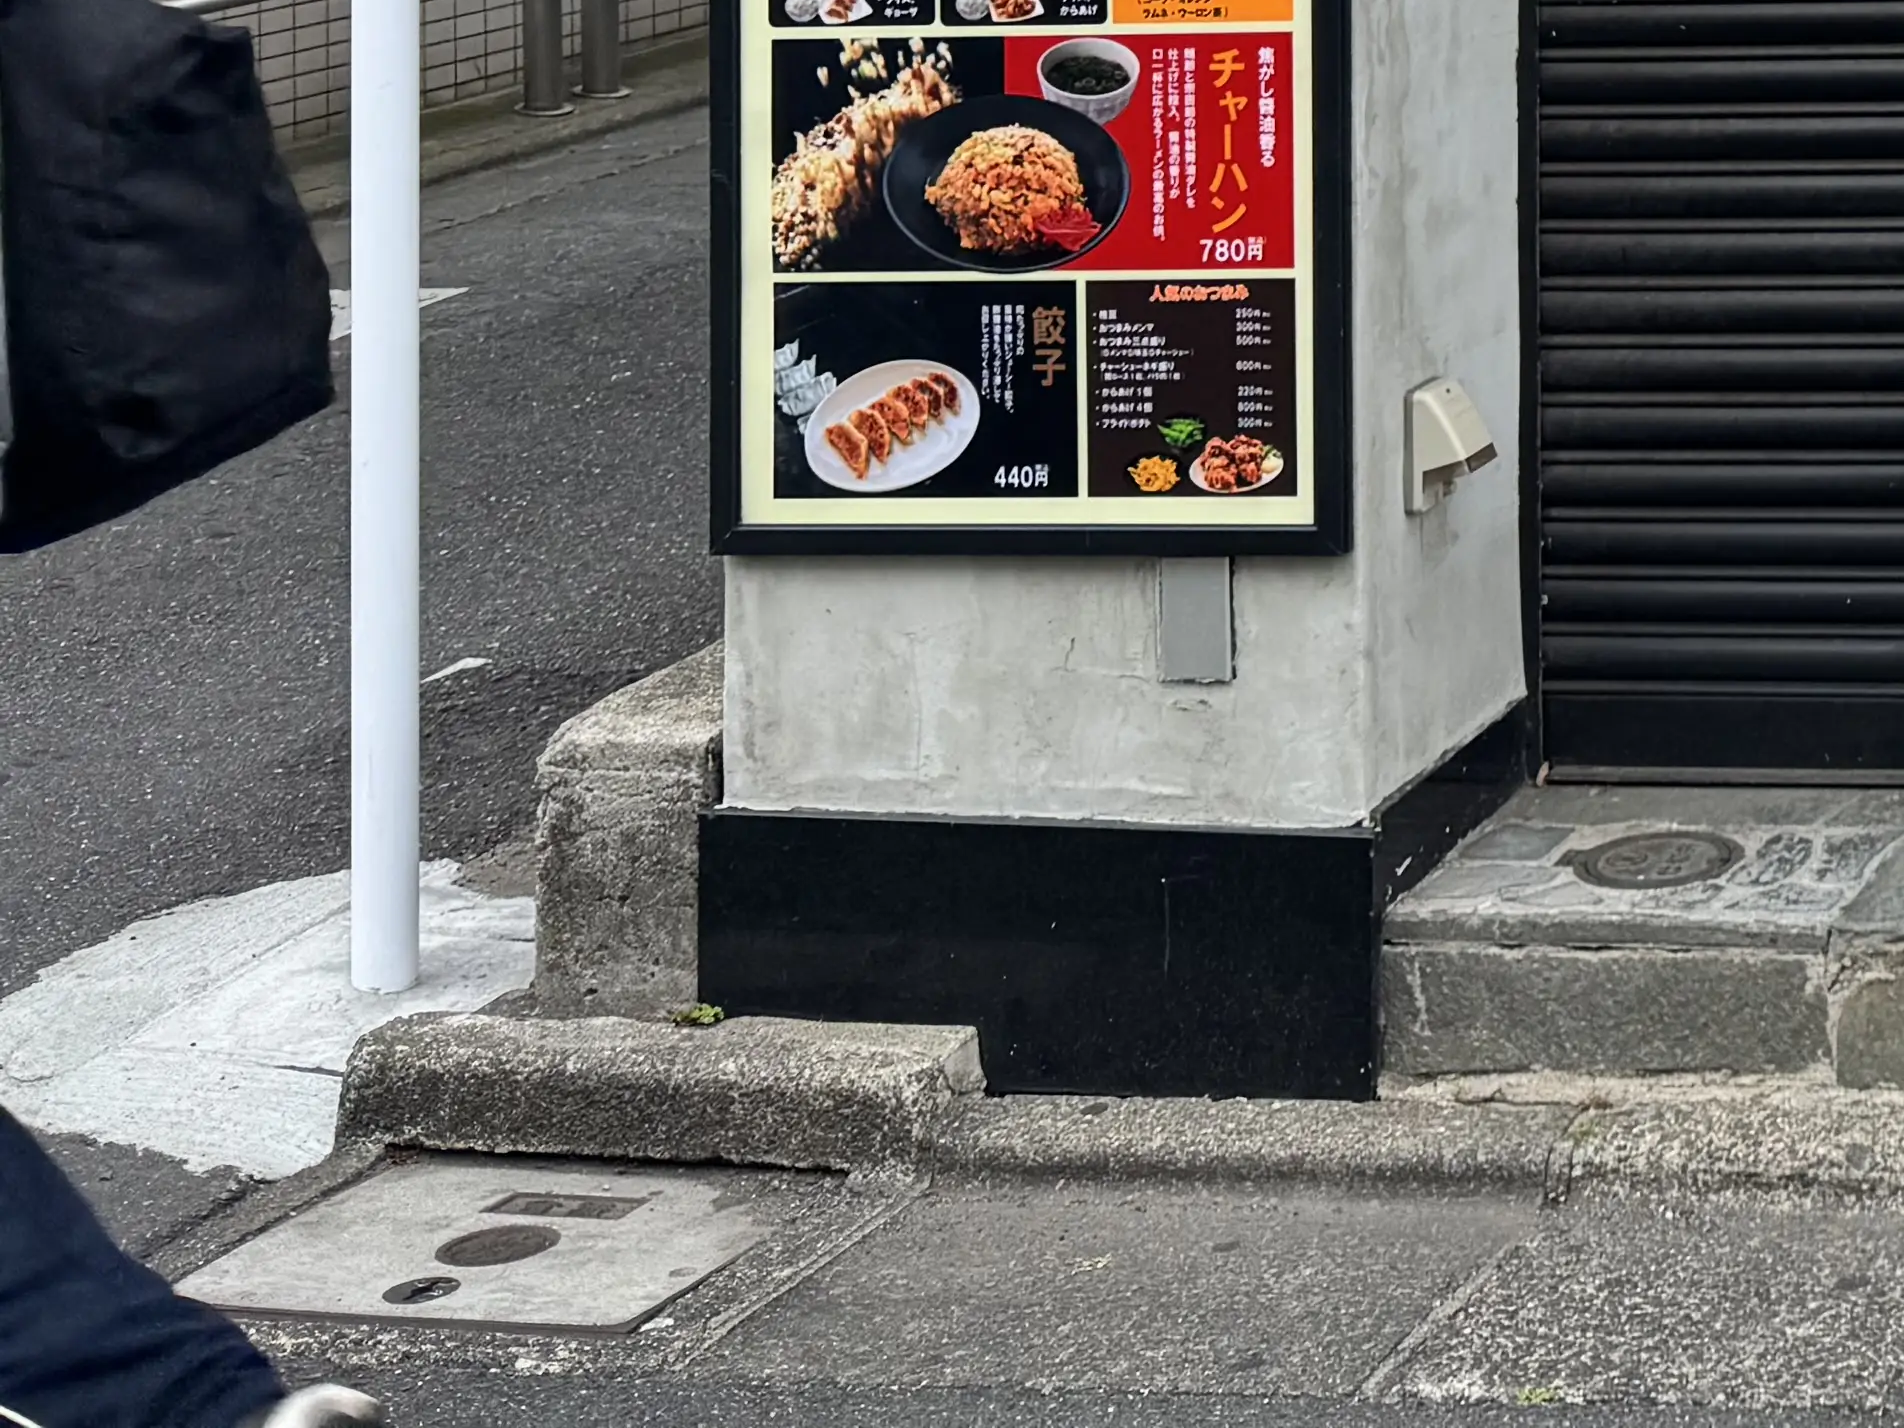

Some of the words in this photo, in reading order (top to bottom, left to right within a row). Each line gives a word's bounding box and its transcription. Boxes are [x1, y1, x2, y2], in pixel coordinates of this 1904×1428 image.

[1209, 48, 1248, 234] チャーハン
[1033, 306, 1066, 387] 餃子
